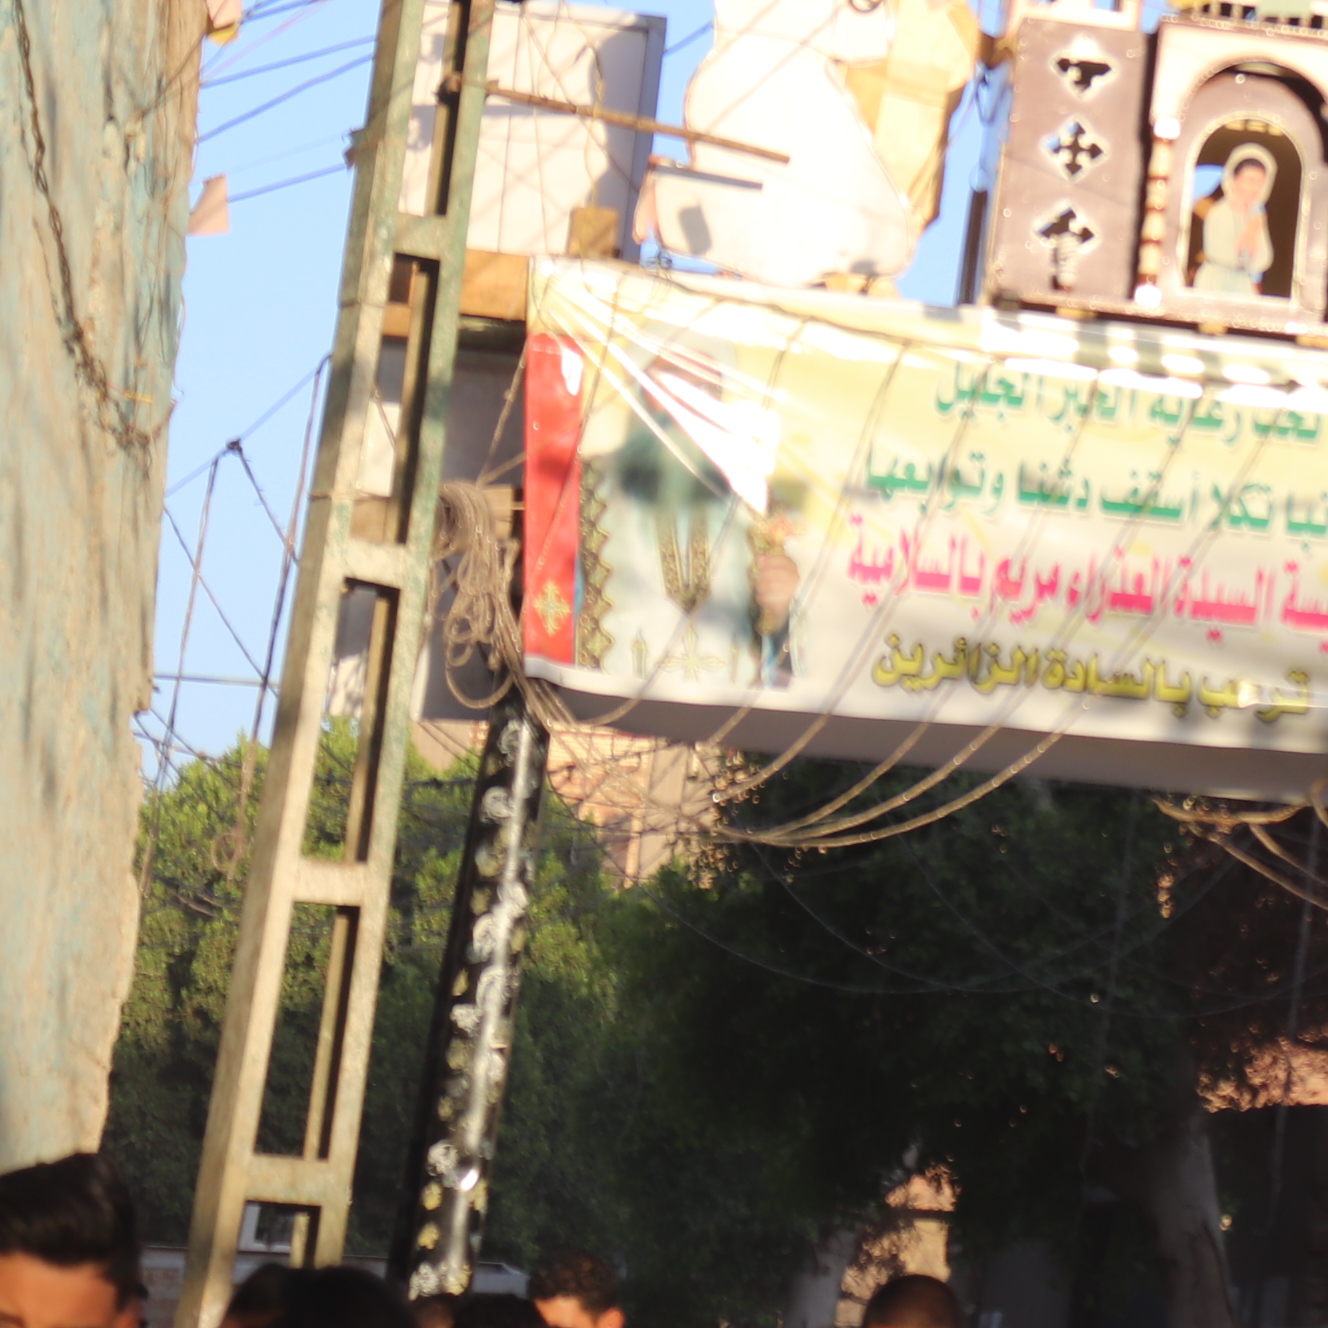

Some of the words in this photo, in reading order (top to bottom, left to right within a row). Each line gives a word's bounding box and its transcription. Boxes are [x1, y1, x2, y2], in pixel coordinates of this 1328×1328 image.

[935, 362, 1044, 422] الجليل
[989, 556, 1061, 626] مريم
[1174, 555, 1276, 644] السيدة
[872, 634, 1039, 695] الزائرين
[1042, 648, 1191, 718] بالسادة
